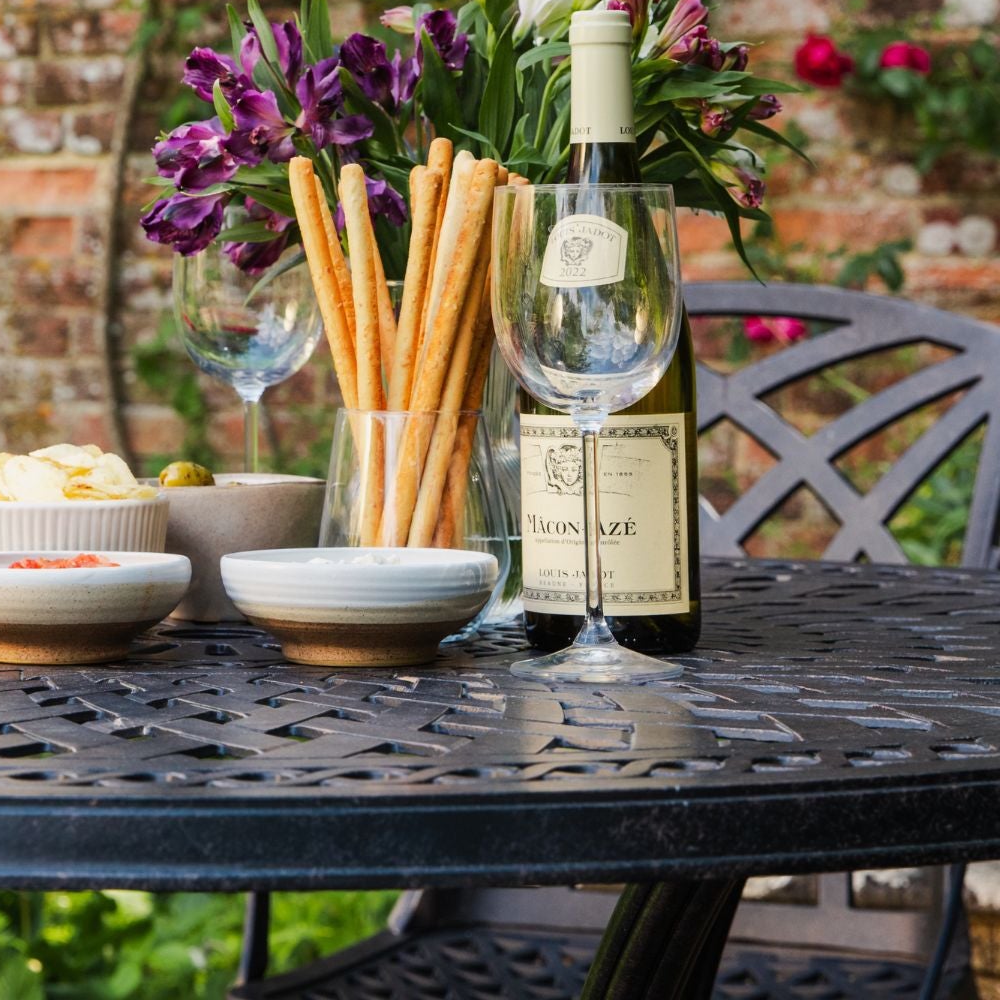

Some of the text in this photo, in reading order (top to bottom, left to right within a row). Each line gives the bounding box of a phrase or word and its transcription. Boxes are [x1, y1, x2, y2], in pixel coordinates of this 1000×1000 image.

[572, 126, 592, 135] ADOT
[581, 226, 616, 243] JADOT
[559, 267, 587, 277] 2022
[527, 513, 637, 536] MÂCON-AZÉ
[539, 568, 617, 580] LOUIS JAOT
